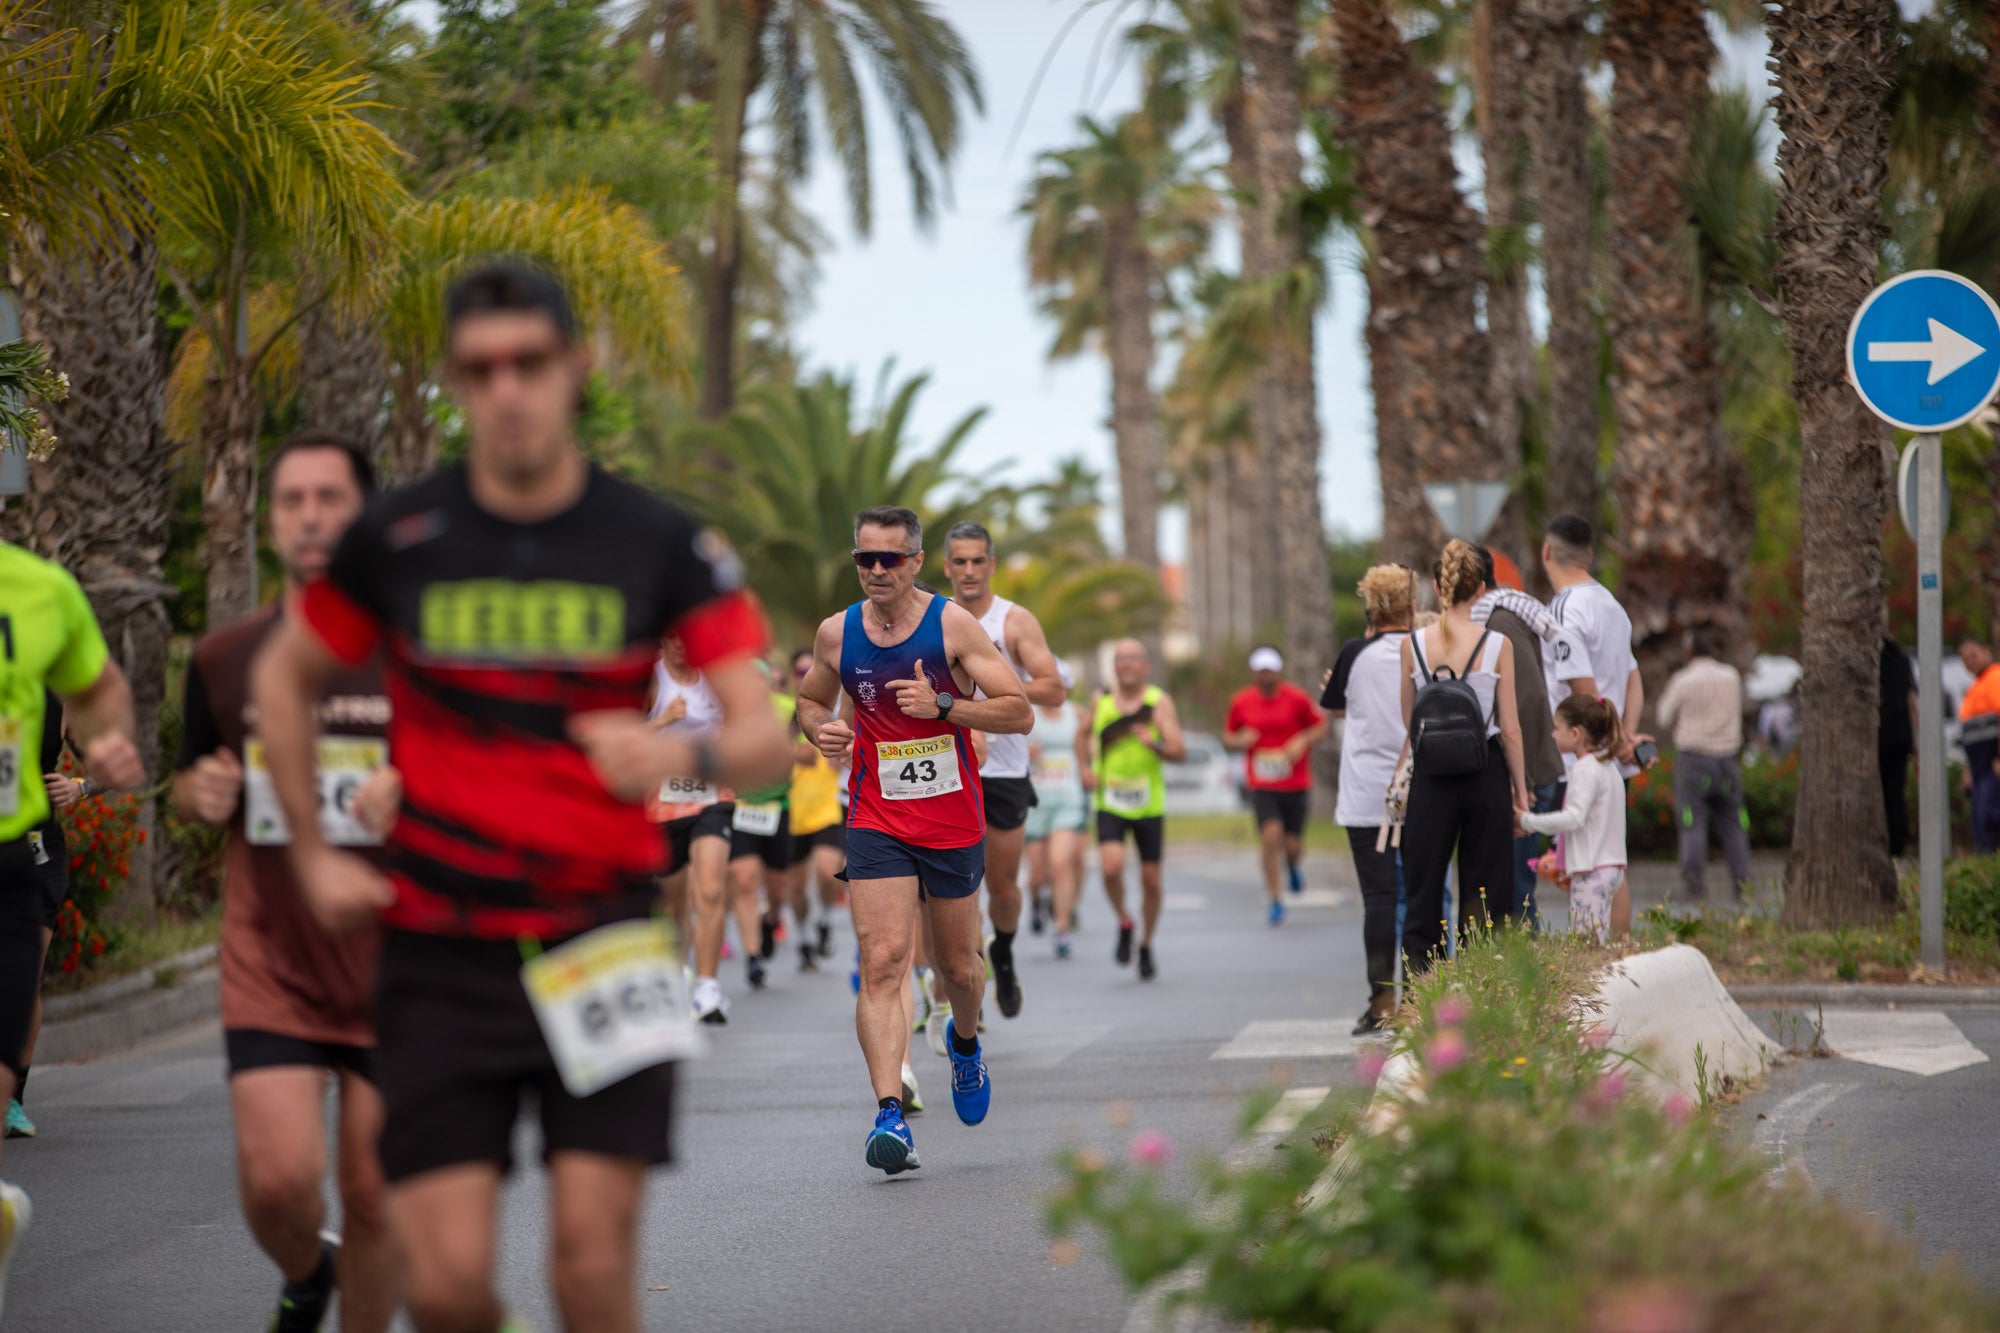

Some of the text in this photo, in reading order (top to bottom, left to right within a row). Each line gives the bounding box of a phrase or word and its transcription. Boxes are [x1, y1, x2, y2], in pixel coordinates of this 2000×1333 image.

[887, 745, 899, 756] 38
[899, 743, 938, 756] FONDO
[899, 760, 938, 784] 43
[669, 777, 707, 794] 684
